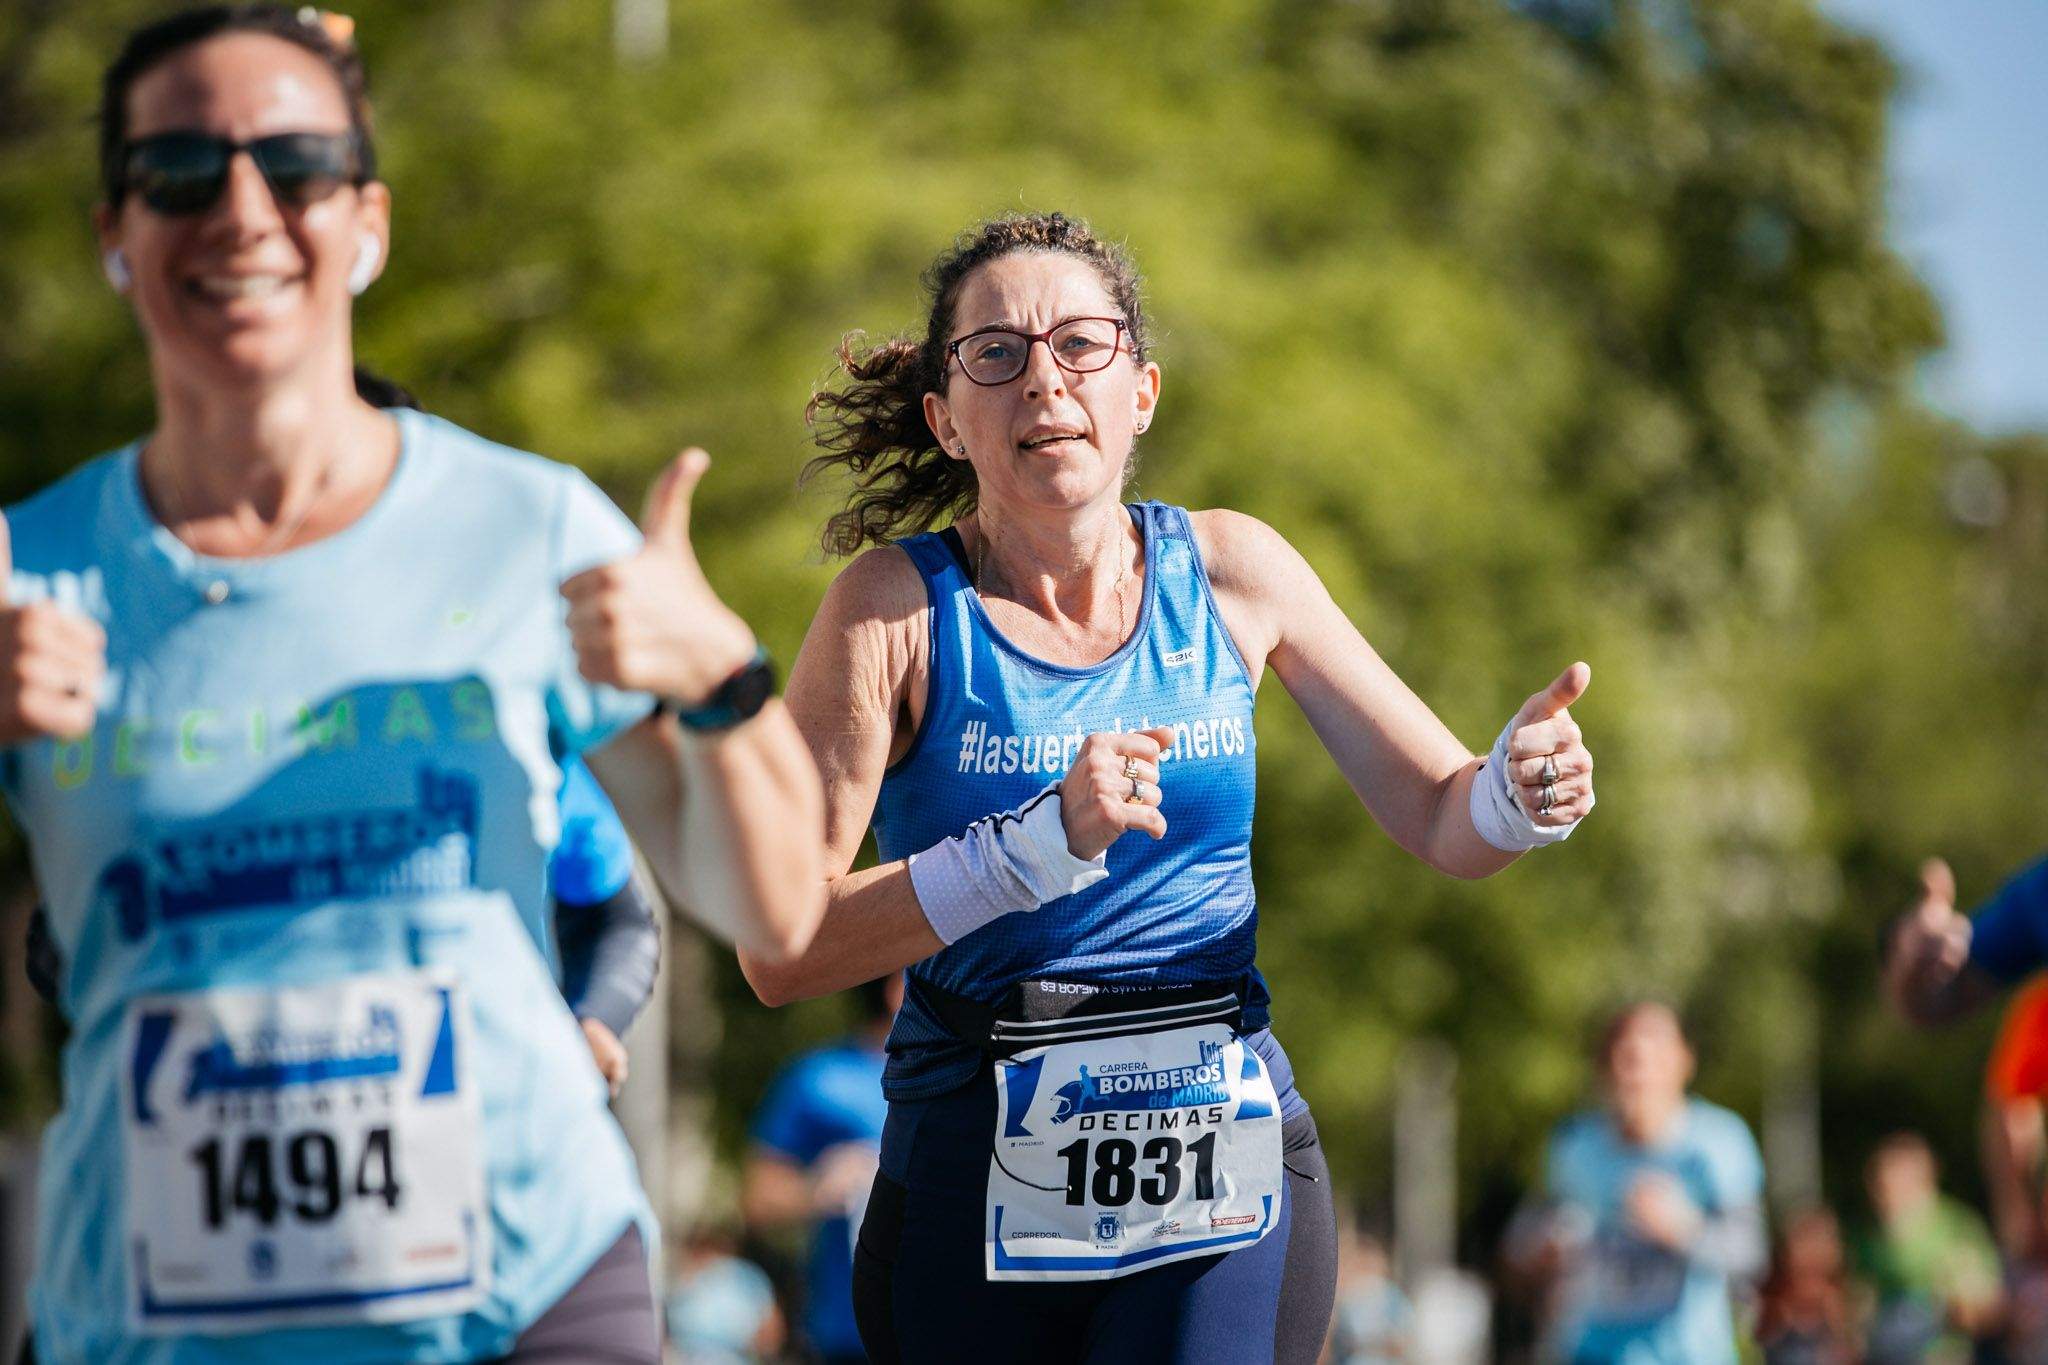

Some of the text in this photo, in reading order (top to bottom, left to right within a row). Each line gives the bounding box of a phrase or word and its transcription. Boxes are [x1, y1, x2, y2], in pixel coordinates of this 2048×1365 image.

[958, 716, 1246, 774] #lasuertneros
[1040, 981, 1056, 993] ES
[1058, 983, 1099, 995] MEJOR
[1099, 1062, 1148, 1074] CARRERA
[1100, 1063, 1222, 1095] BOMBEROS
[1149, 1082, 1228, 1108] de MADRID
[1078, 1106, 1223, 1131] DECIMAS
[190, 1127, 401, 1230] 1494
[1057, 1131, 1216, 1206] 1831
